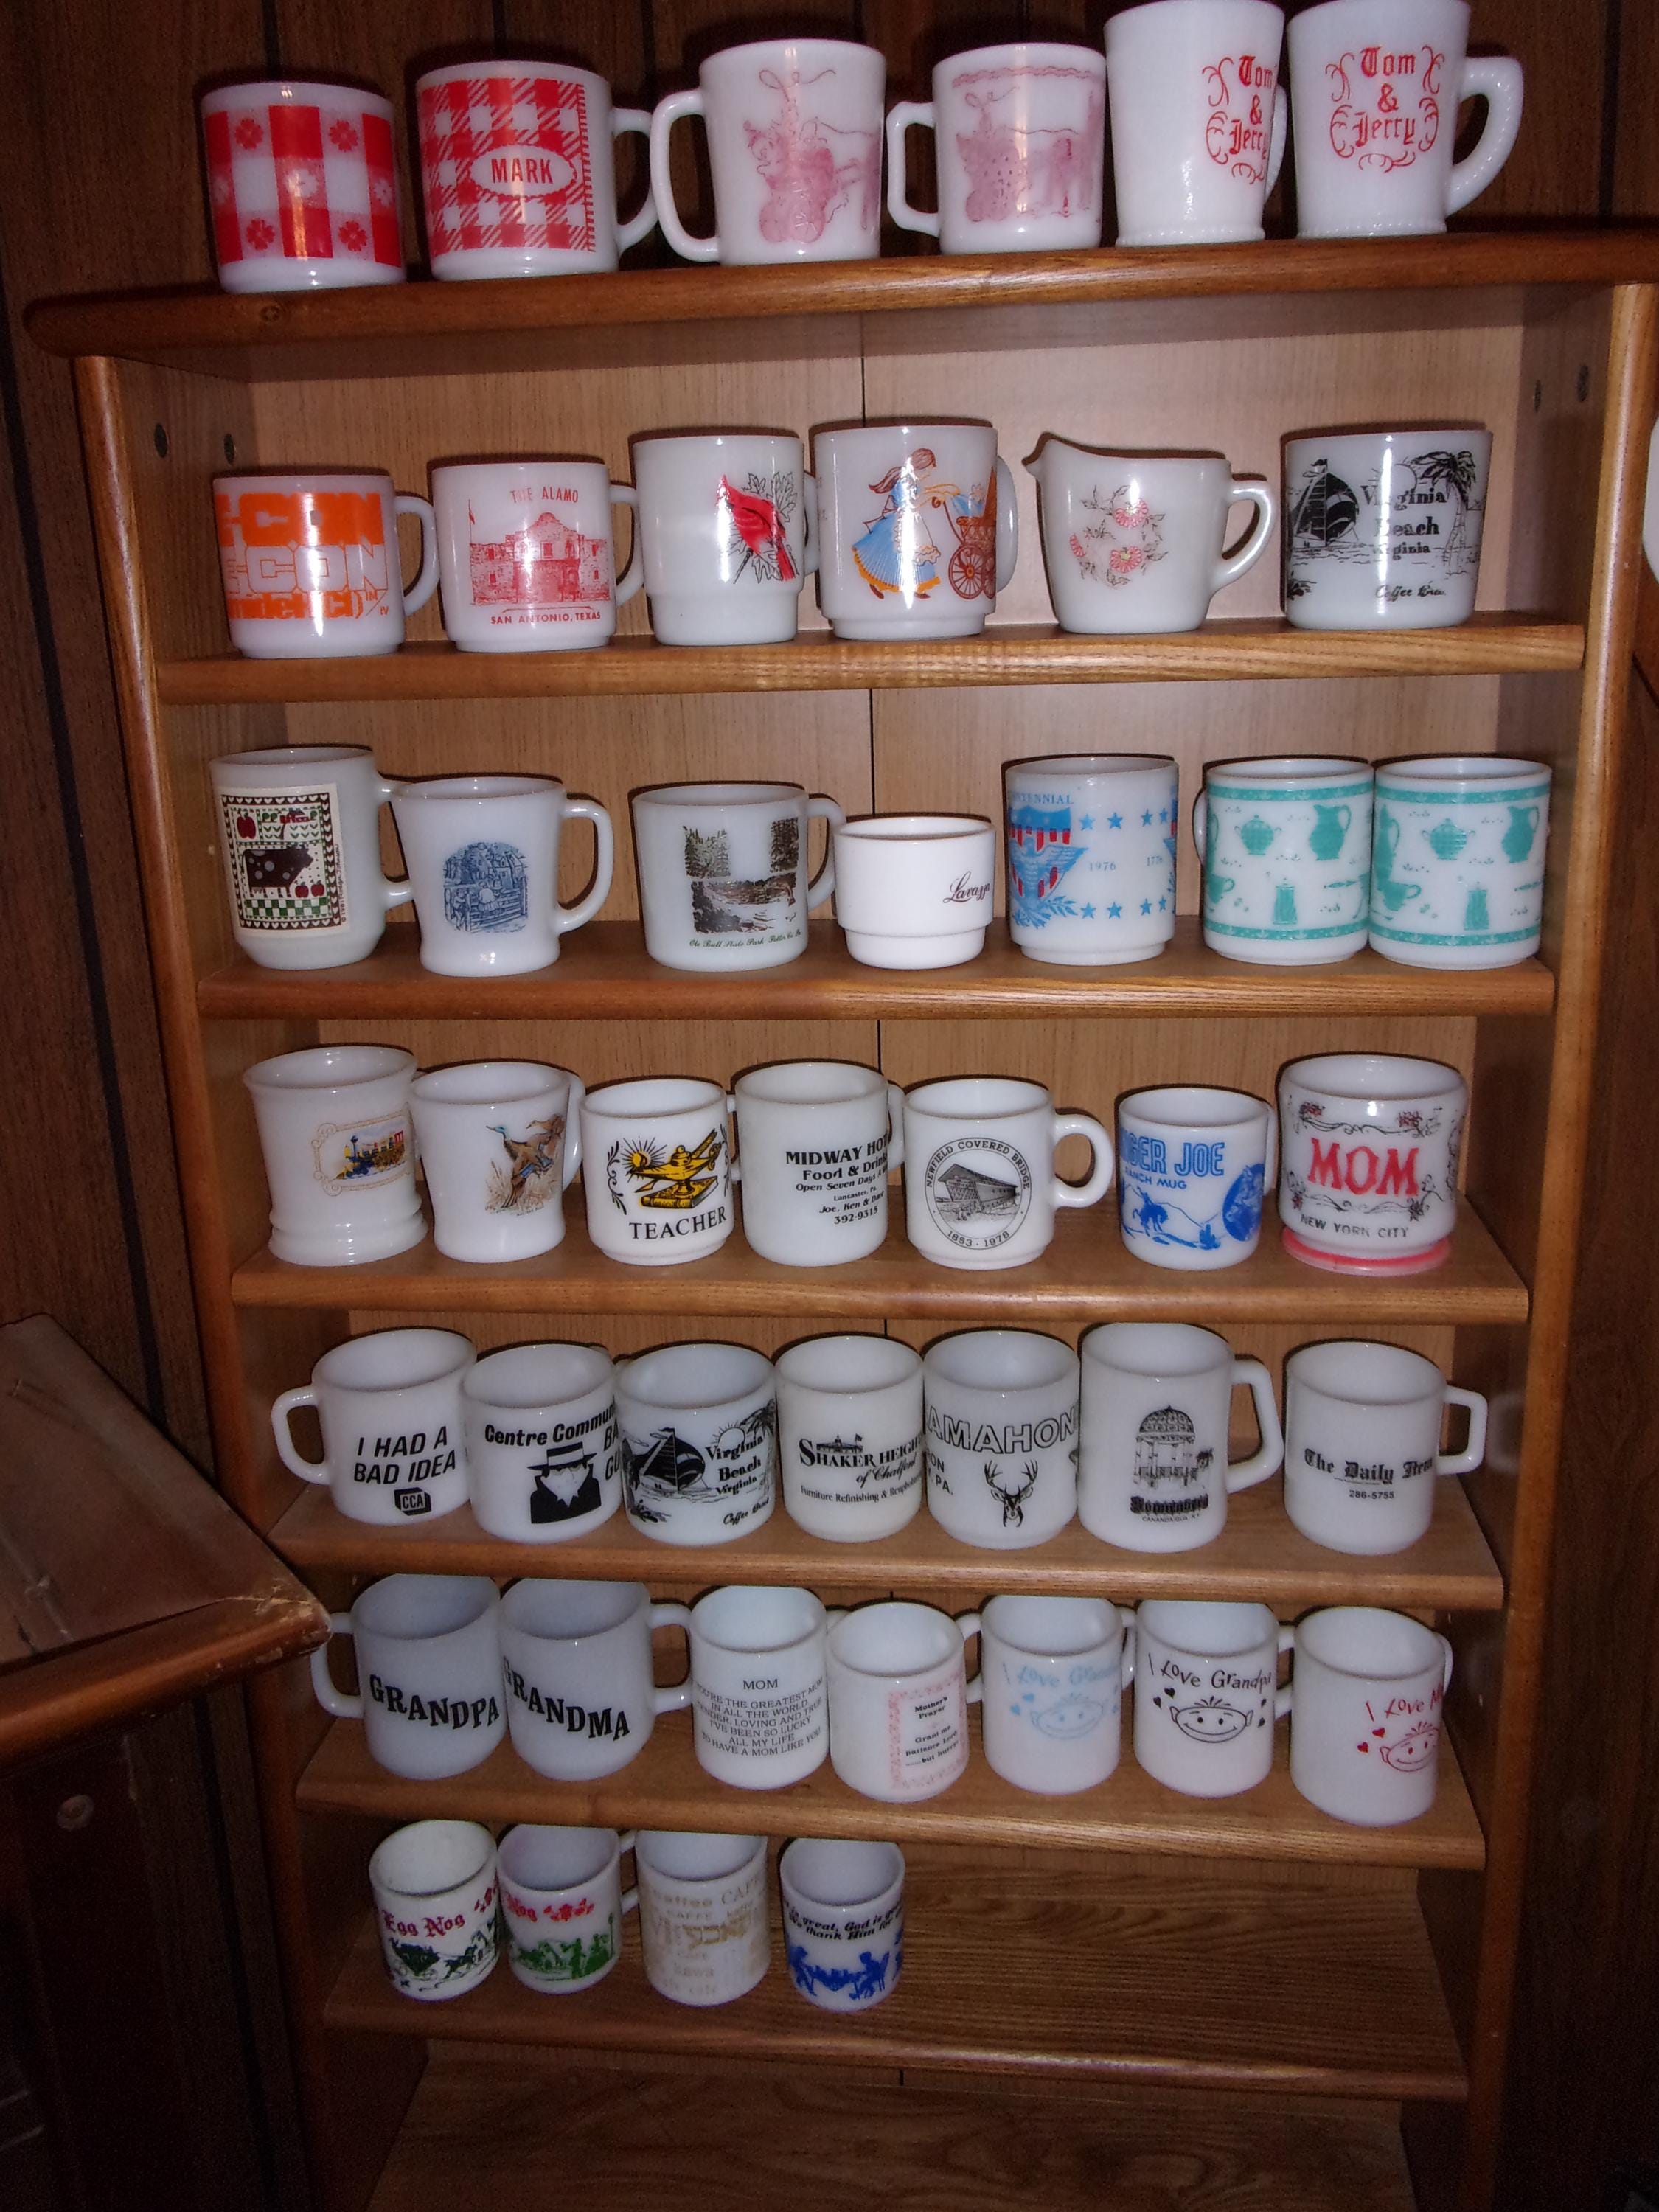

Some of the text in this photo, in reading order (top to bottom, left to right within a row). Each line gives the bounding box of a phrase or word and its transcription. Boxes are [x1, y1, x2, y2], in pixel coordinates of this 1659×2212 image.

[1239, 55, 1273, 87] Tom
[1360, 46, 1415, 77] Tom
[1248, 94, 1263, 125] &
[1377, 83, 1398, 114] &
[1355, 111, 1416, 147] Jerry
[491, 156, 554, 184] MARK
[542, 487, 579, 503] ALAMO
[1360, 484, 1447, 511] Viginia
[490, 616, 512, 625] SAN
[575, 611, 601, 621] TEXAS
[1088, 861, 1117, 872] 1976
[746, 938, 765, 946] Park
[785, 1146, 863, 1166] MIDWAY
[926, 1140, 1030, 1190] NEWFIELD COVERED BRIDGE
[1175, 1142, 1225, 1178] JOE
[1307, 1137, 1420, 1197] MOM
[796, 1183, 823, 1193] Open
[826, 1180, 855, 1191] Seven
[858, 1172, 876, 1185] Days
[802, 1167, 843, 1180] Food
[848, 1165, 859, 1177] &
[1156, 1178, 1187, 1189] MUG
[819, 1206, 840, 1214] Joe,
[843, 1201, 860, 1211] Ken
[863, 1197, 870, 1206] &
[834, 1205, 878, 1225] 392-9315
[628, 1206, 728, 1241] TEACHER
[1300, 1214, 1409, 1238] NEW YORK CITY
[984, 1230, 1010, 1248] 1978
[358, 1426, 448, 1458] I HAD A
[484, 1424, 548, 1447] Centre
[705, 1435, 764, 1461] Virginia
[799, 1438, 877, 1467] SHAKER
[354, 1450, 456, 1485] BAD IDEA
[718, 1455, 762, 1482] Beach
[1304, 1447, 1335, 1474] The
[1344, 1459, 1394, 1485] Daily
[715, 1476, 757, 1496] Virginia
[856, 1467, 872, 1489] of
[402, 1492, 425, 1511] CCA
[801, 1484, 833, 1502] Furniture
[835, 1492, 880, 1503] Refinishing
[881, 1489, 888, 1499] &
[1349, 1489, 1395, 1500] 286-5755
[723, 1511, 749, 1526] Coffee
[1148, 1652, 1155, 1676] I
[1161, 1660, 1201, 1688] Love
[725, 1697, 748, 1709] THE
[750, 1690, 807, 1709] GREATEST
[807, 1676, 823, 1696] MOM
[742, 1678, 779, 1691] MOM
[369, 1674, 500, 1730] GRANDPA
[712, 1699, 809, 1719] IN ALL THE WORLD
[734, 1718, 776, 1728] LOVING
[780, 1711, 802, 1725] AND
[804, 1696, 822, 1716] TRUE
[919, 1705, 945, 1719] Prayer
[1366, 1700, 1375, 1722] I
[1384, 1698, 1425, 1719] Love
[731, 1728, 762, 1738] BEEN
[764, 1728, 779, 1737] SO
[781, 1715, 811, 1733] LUCKY
[915, 1731, 939, 1744] Grant
[943, 1731, 958, 1744] Lord
[712, 1739, 739, 1755] HAVE
[741, 1748, 749, 1756] A
[751, 1747, 779, 1757] MOM
[781, 1739, 804, 1754] LIKE
[728, 1733, 795, 1747] ALL MY LIFE
[382, 1910, 466, 1938] Egg Nog
[806, 1926, 842, 1941] thank
[844, 1919, 870, 1932] God
